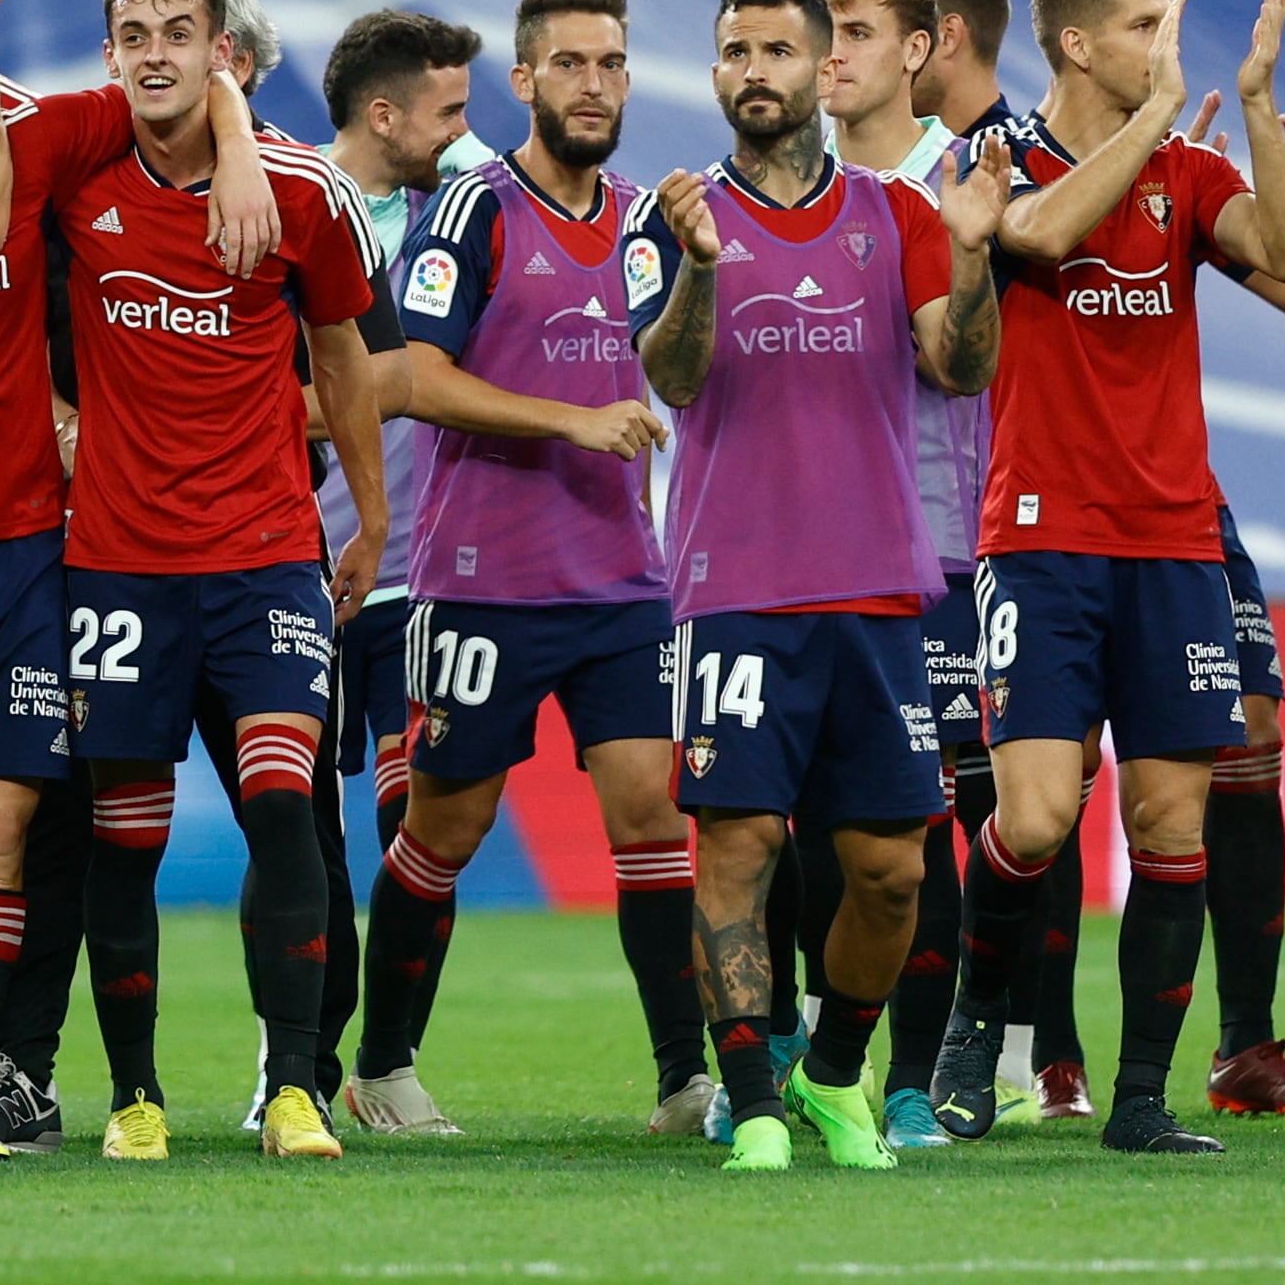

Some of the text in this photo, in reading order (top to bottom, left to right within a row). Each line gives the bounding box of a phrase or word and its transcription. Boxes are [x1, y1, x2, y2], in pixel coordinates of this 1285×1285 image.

[92, 221, 123, 234] adidas
[715, 251, 755, 263] adidas
[631, 277, 658, 296] LaLiga
[410, 291, 446, 309] LaLiga
[102, 296, 231, 337] verleal
[733, 318, 865, 356] verleal
[268, 609, 317, 630] Clínica
[69, 606, 144, 683] 22
[989, 600, 1019, 671] 8
[271, 639, 292, 655] de
[1185, 643, 1225, 659] Clínica
[11, 665, 58, 685] Clínica
[433, 630, 499, 706] 10
[695, 651, 765, 730] 14
[1189, 676, 1209, 691] de
[9, 699, 29, 716] de
[941, 709, 980, 721] adidas
